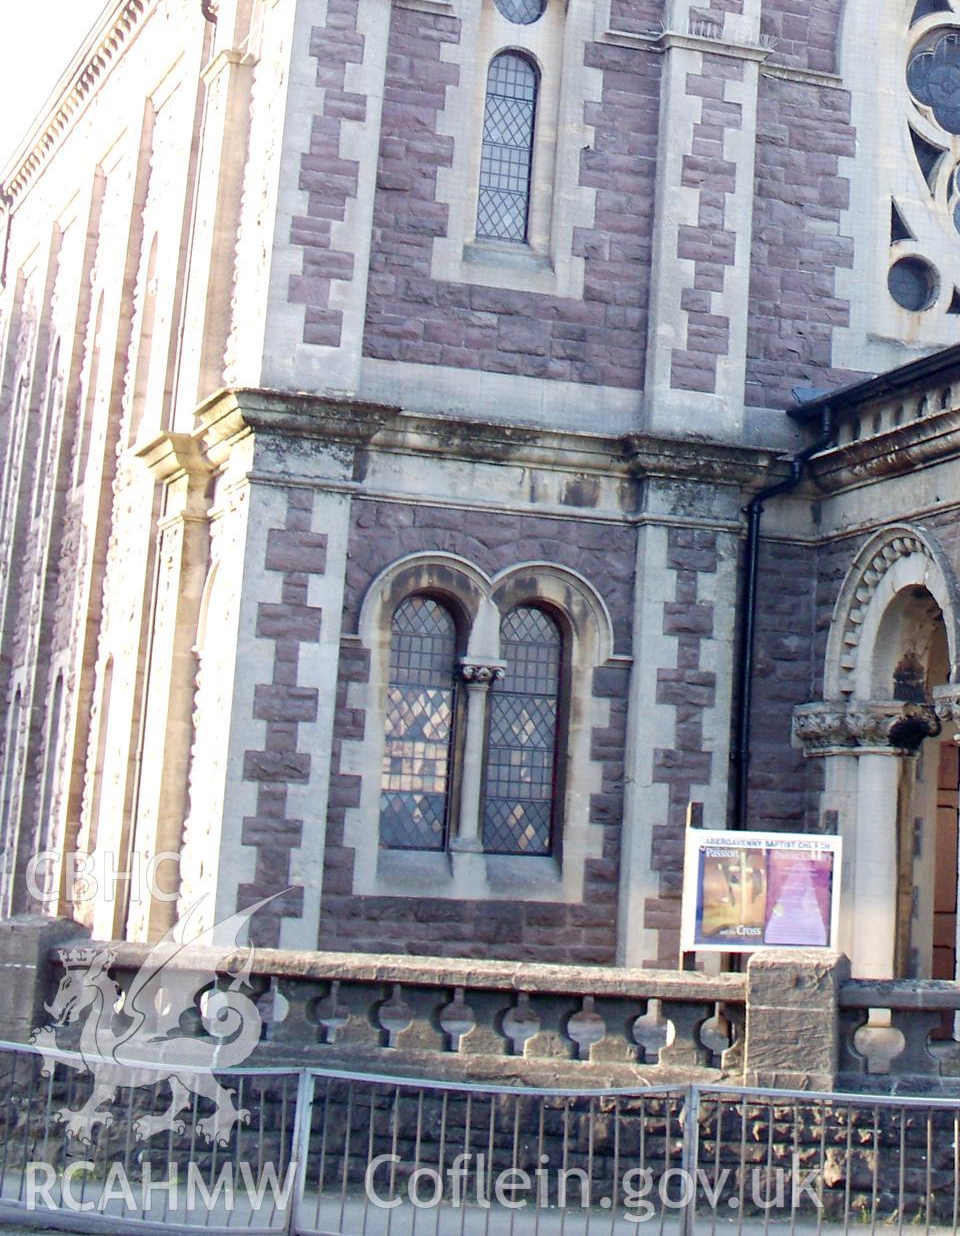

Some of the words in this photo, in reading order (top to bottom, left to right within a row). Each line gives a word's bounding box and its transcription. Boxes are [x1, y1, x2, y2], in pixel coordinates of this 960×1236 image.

[766, 840, 795, 848] BAPTIST
[705, 847, 739, 858] Passion
[736, 924, 761, 935] Cross
